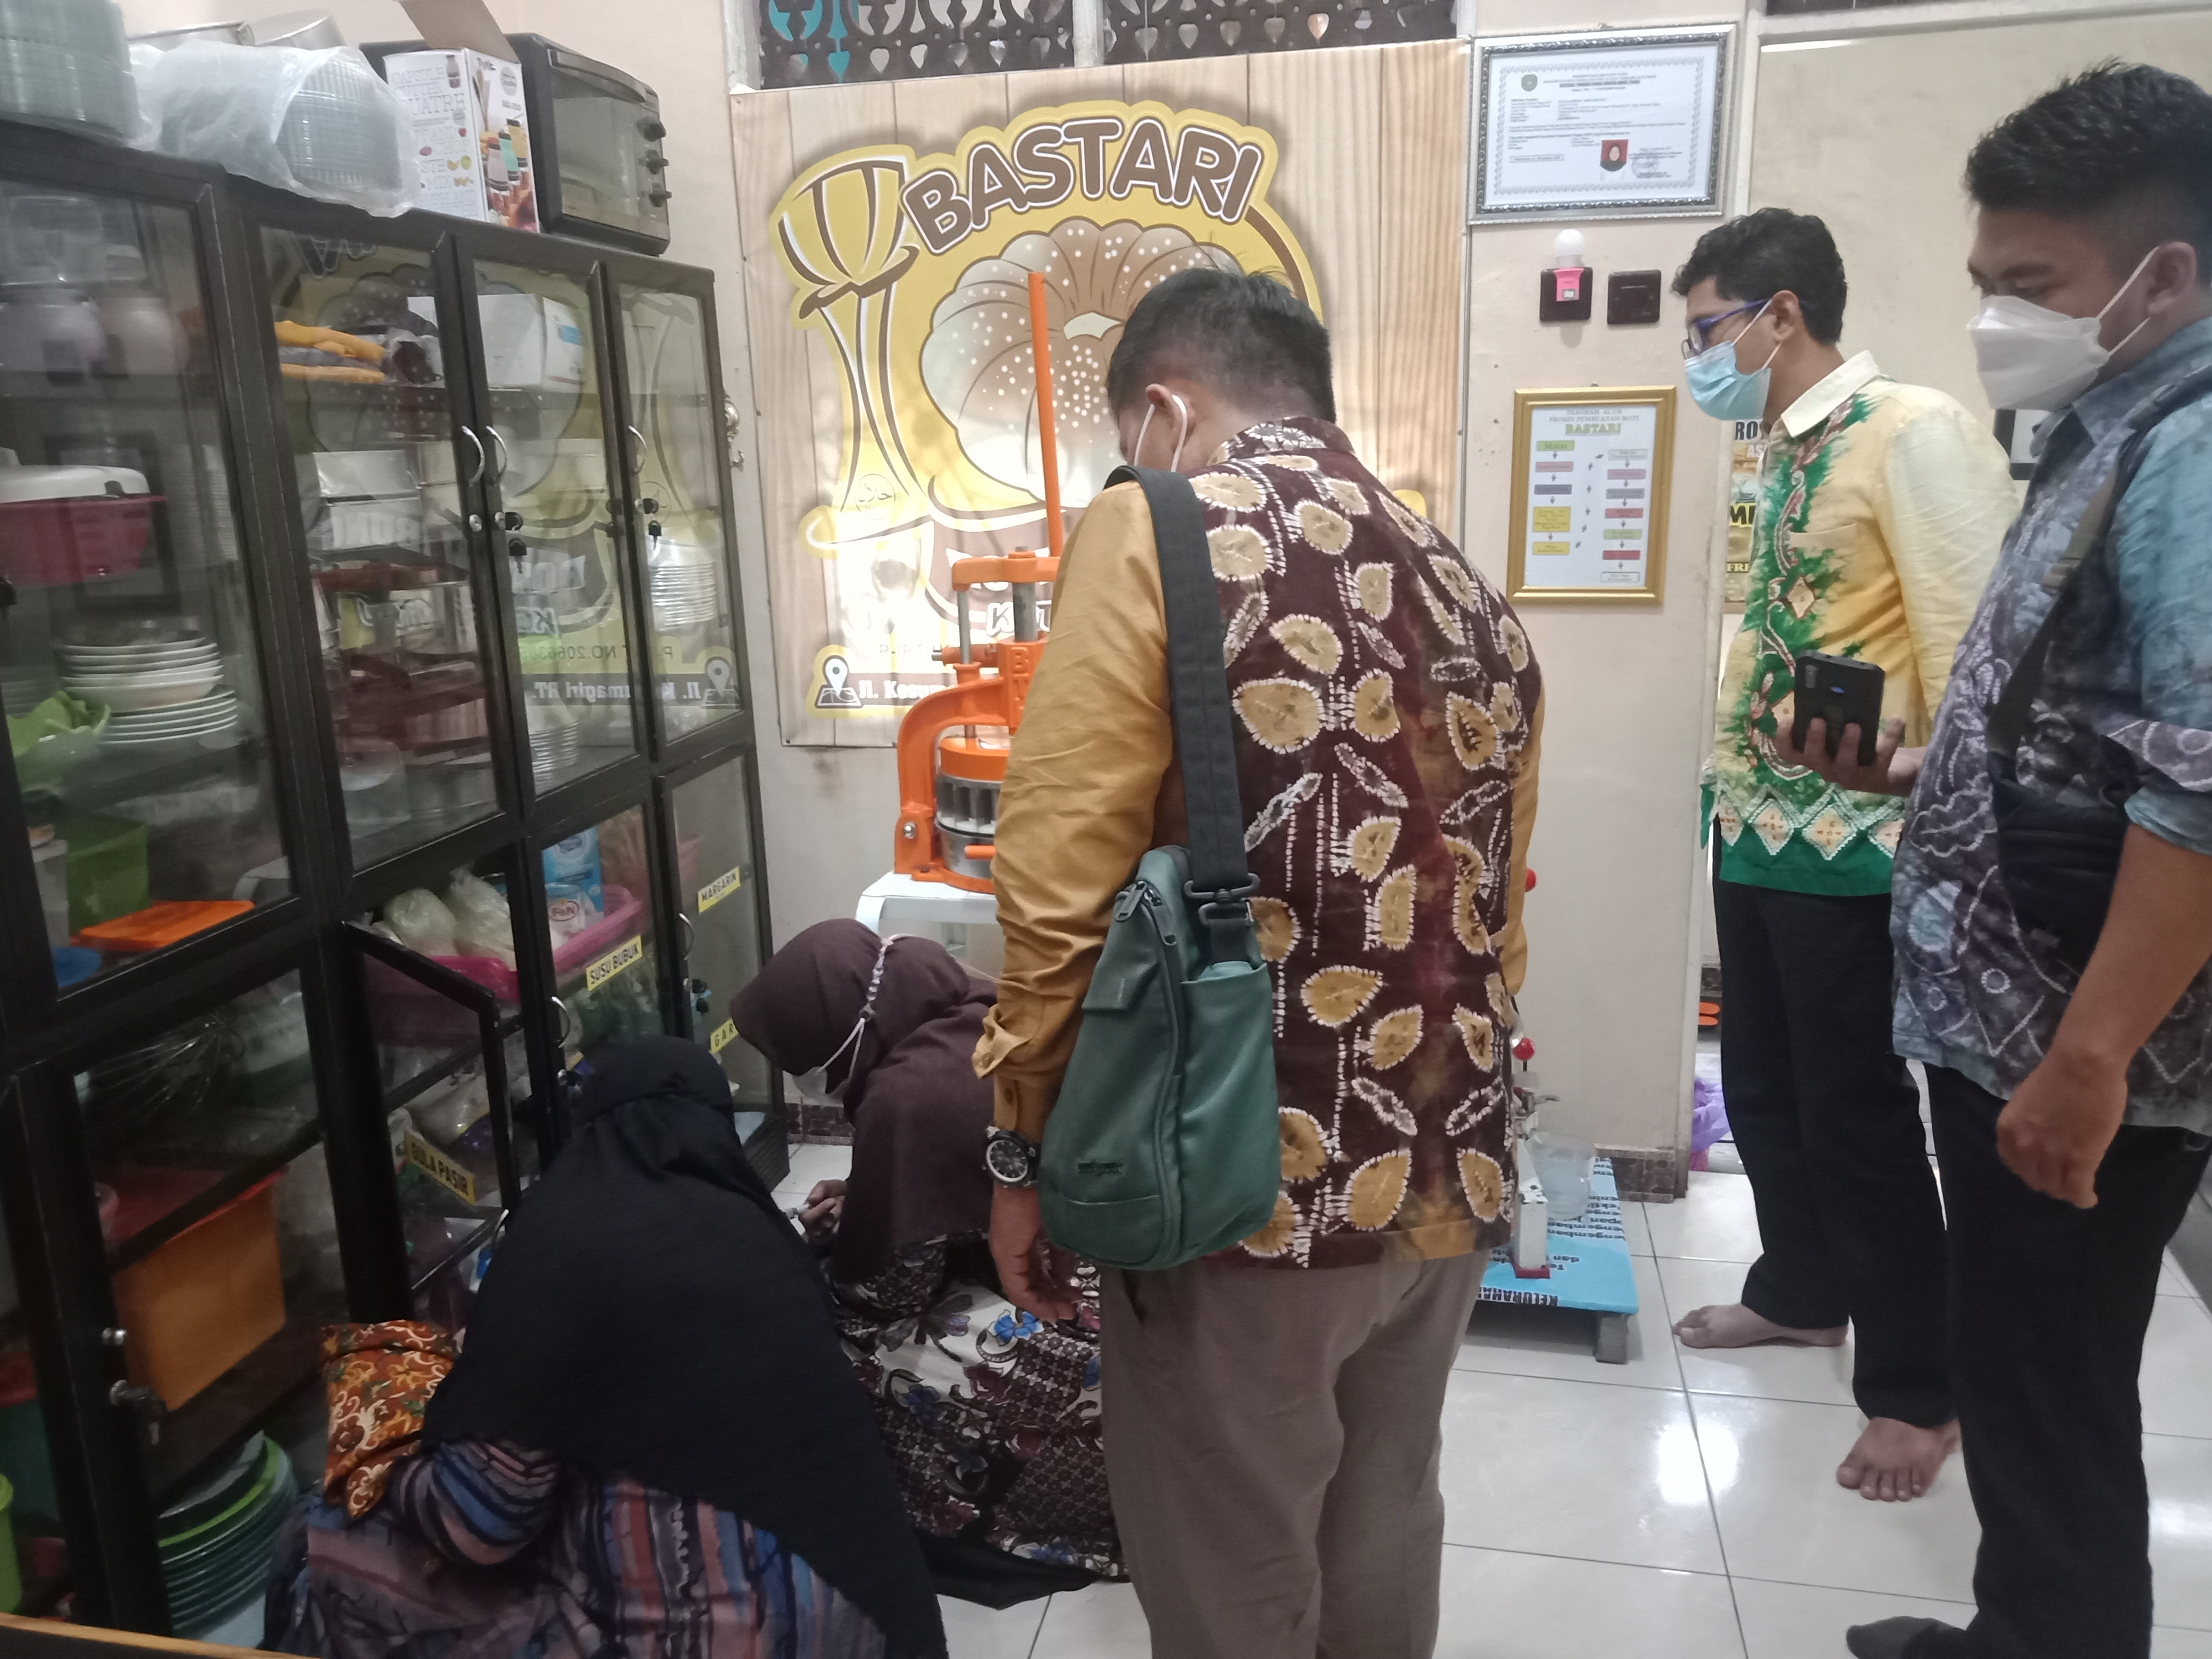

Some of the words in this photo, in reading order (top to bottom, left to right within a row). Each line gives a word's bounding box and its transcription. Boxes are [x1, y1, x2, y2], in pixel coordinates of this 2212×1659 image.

[902, 116, 1263, 254] BASTARI
[702, 873, 736, 902] MARGARIN
[590, 959, 611, 985] SUSU
[613, 944, 639, 969] BUBUK
[411, 1142, 436, 1174] GULA
[438, 1160, 468, 1196] PASIR
